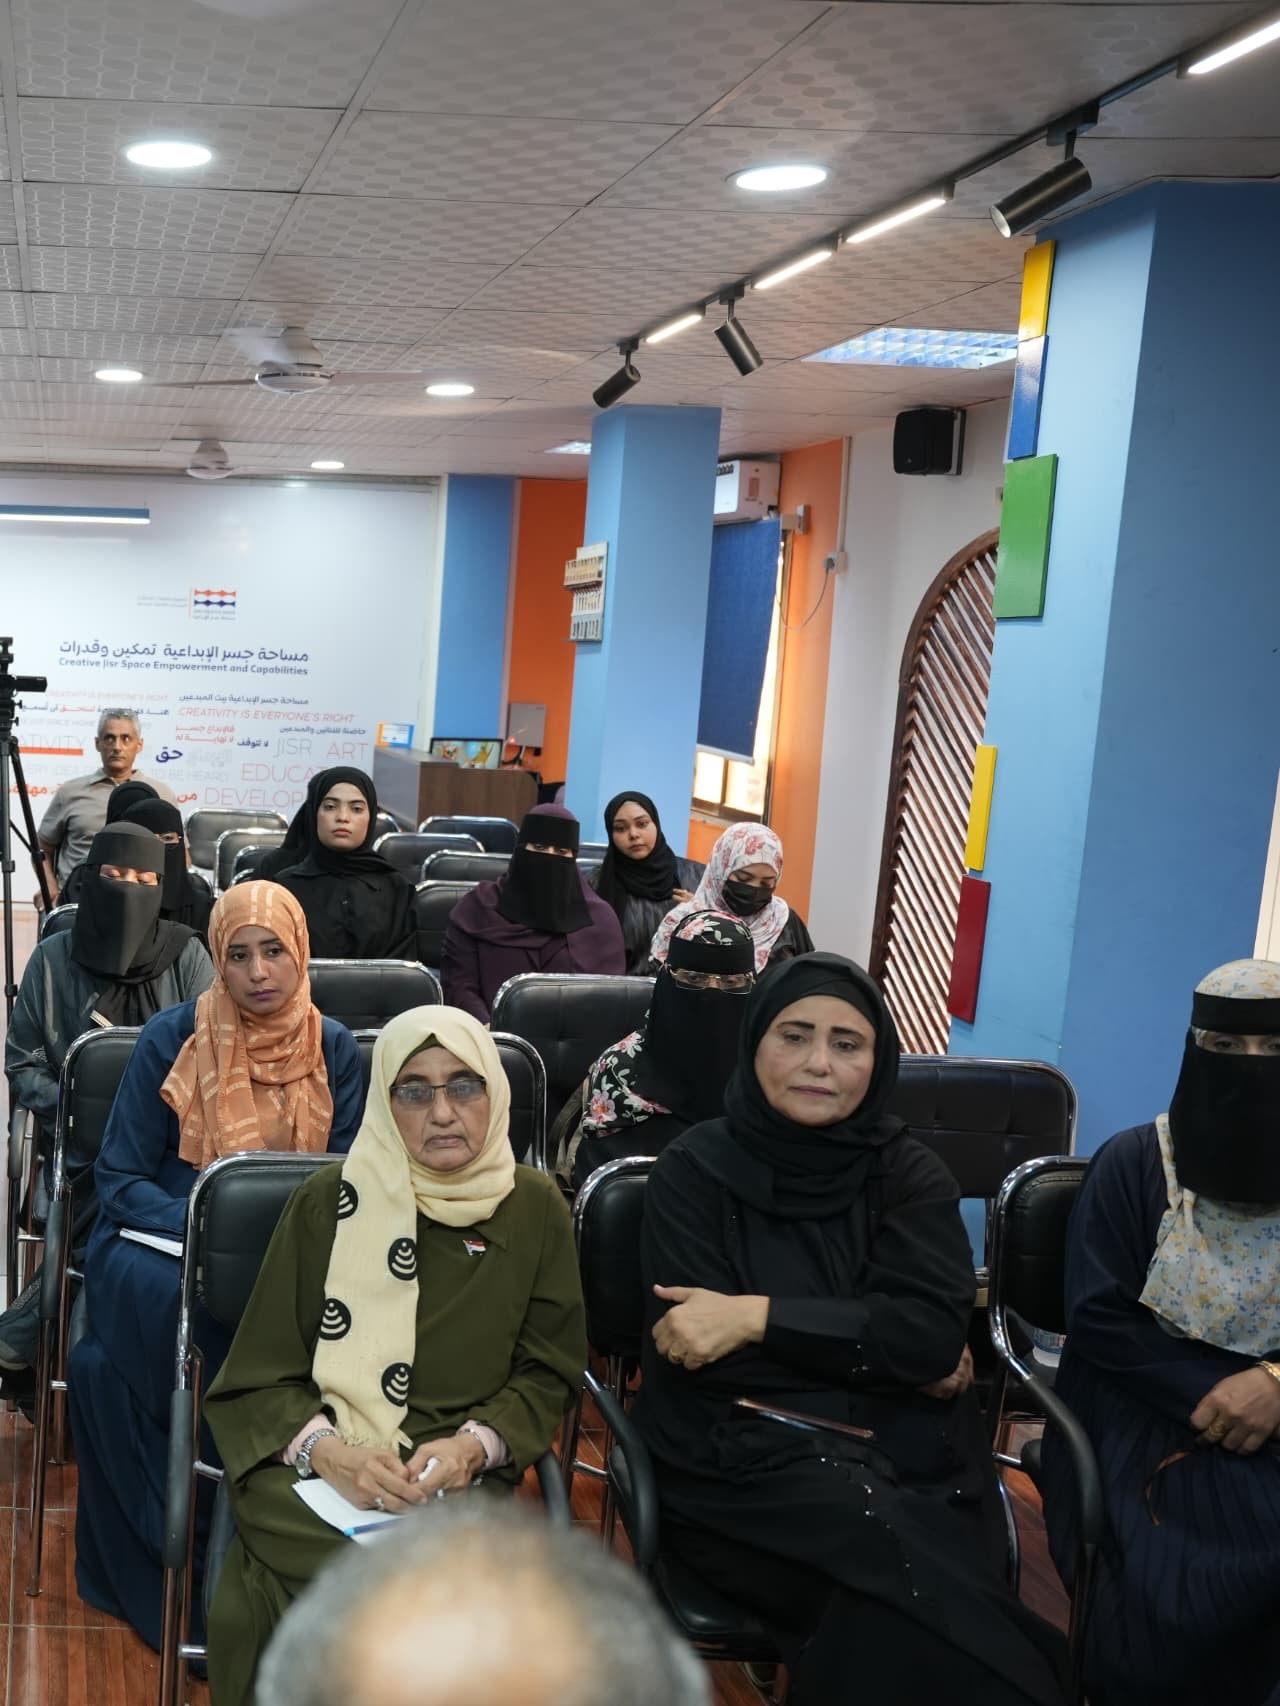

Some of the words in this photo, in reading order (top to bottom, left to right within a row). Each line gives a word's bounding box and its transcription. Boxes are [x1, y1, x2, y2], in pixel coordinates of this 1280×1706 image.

[59, 639, 109, 657] وقدرات
[112, 643, 157, 658] تمكين
[163, 643, 219, 662] الإبداعية
[258, 648, 308, 662] مساحة
[221, 649, 254, 663] جسر
[59, 657, 101, 667] Creative
[103, 659, 118, 669] Jisr
[122, 660, 151, 670] Space
[153, 661, 227, 672] Empowerment
[230, 664, 248, 673] and
[250, 665, 308, 676] Capabilities
[179, 694, 213, 702] المبدعين
[215, 695, 227, 703] بيت
[229, 694, 260, 704] الإبداعية
[280, 696, 309, 705] مساحة
[178, 707, 238, 718] CREATIVITY
[240, 709, 250, 719] IS
[253, 710, 320, 722] EVERYONE'S
[322, 712, 355, 723] RIGHT
[155, 746, 183, 763] حق
[272, 738, 313, 758] JISR
[326, 741, 369, 760] ART
[240, 763, 326, 782] EDUCA
[176, 793, 197, 803] من
[204, 787, 303, 808] DEVELOP
